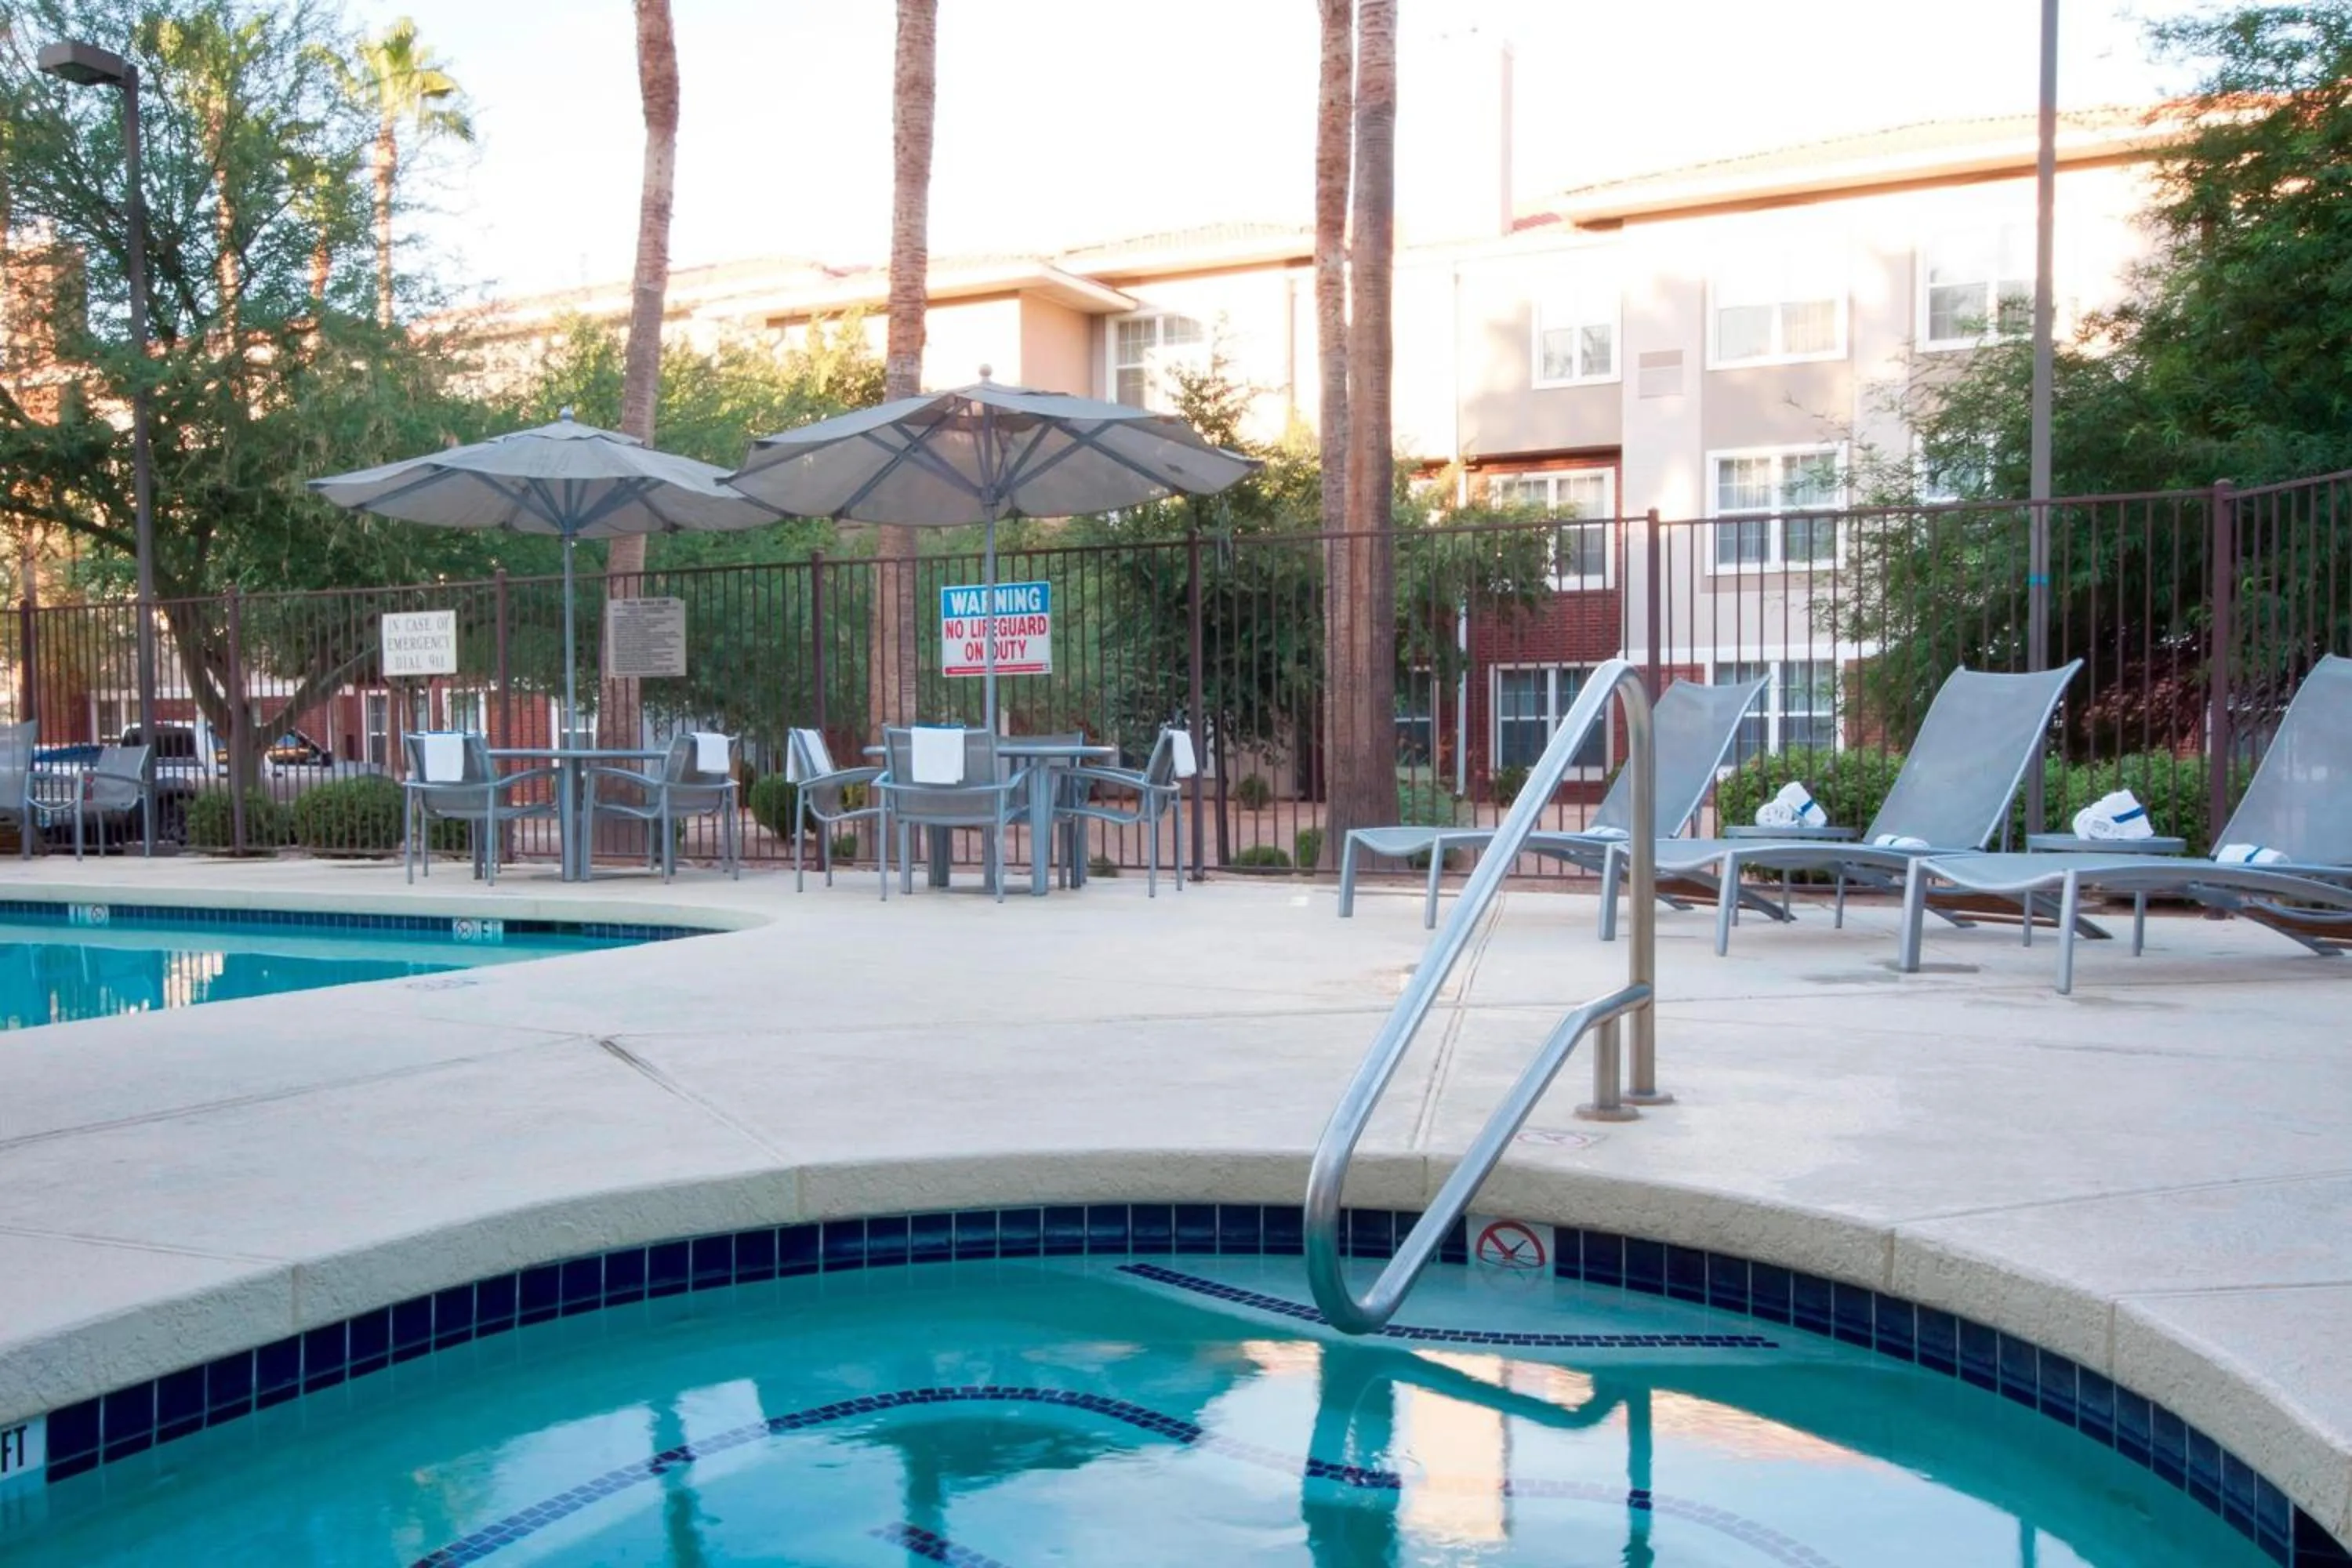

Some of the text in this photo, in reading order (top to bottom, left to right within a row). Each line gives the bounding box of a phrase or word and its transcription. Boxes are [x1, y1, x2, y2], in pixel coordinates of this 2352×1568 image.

[387, 613, 450, 632] IN CASE OF
[945, 615, 1047, 640] NO LIFEGUARD
[387, 634, 452, 652] EMERGENCY
[965, 641, 985, 662] ON
[394, 653, 445, 670] DIAL 911
[2, 1424, 27, 1473] FT
